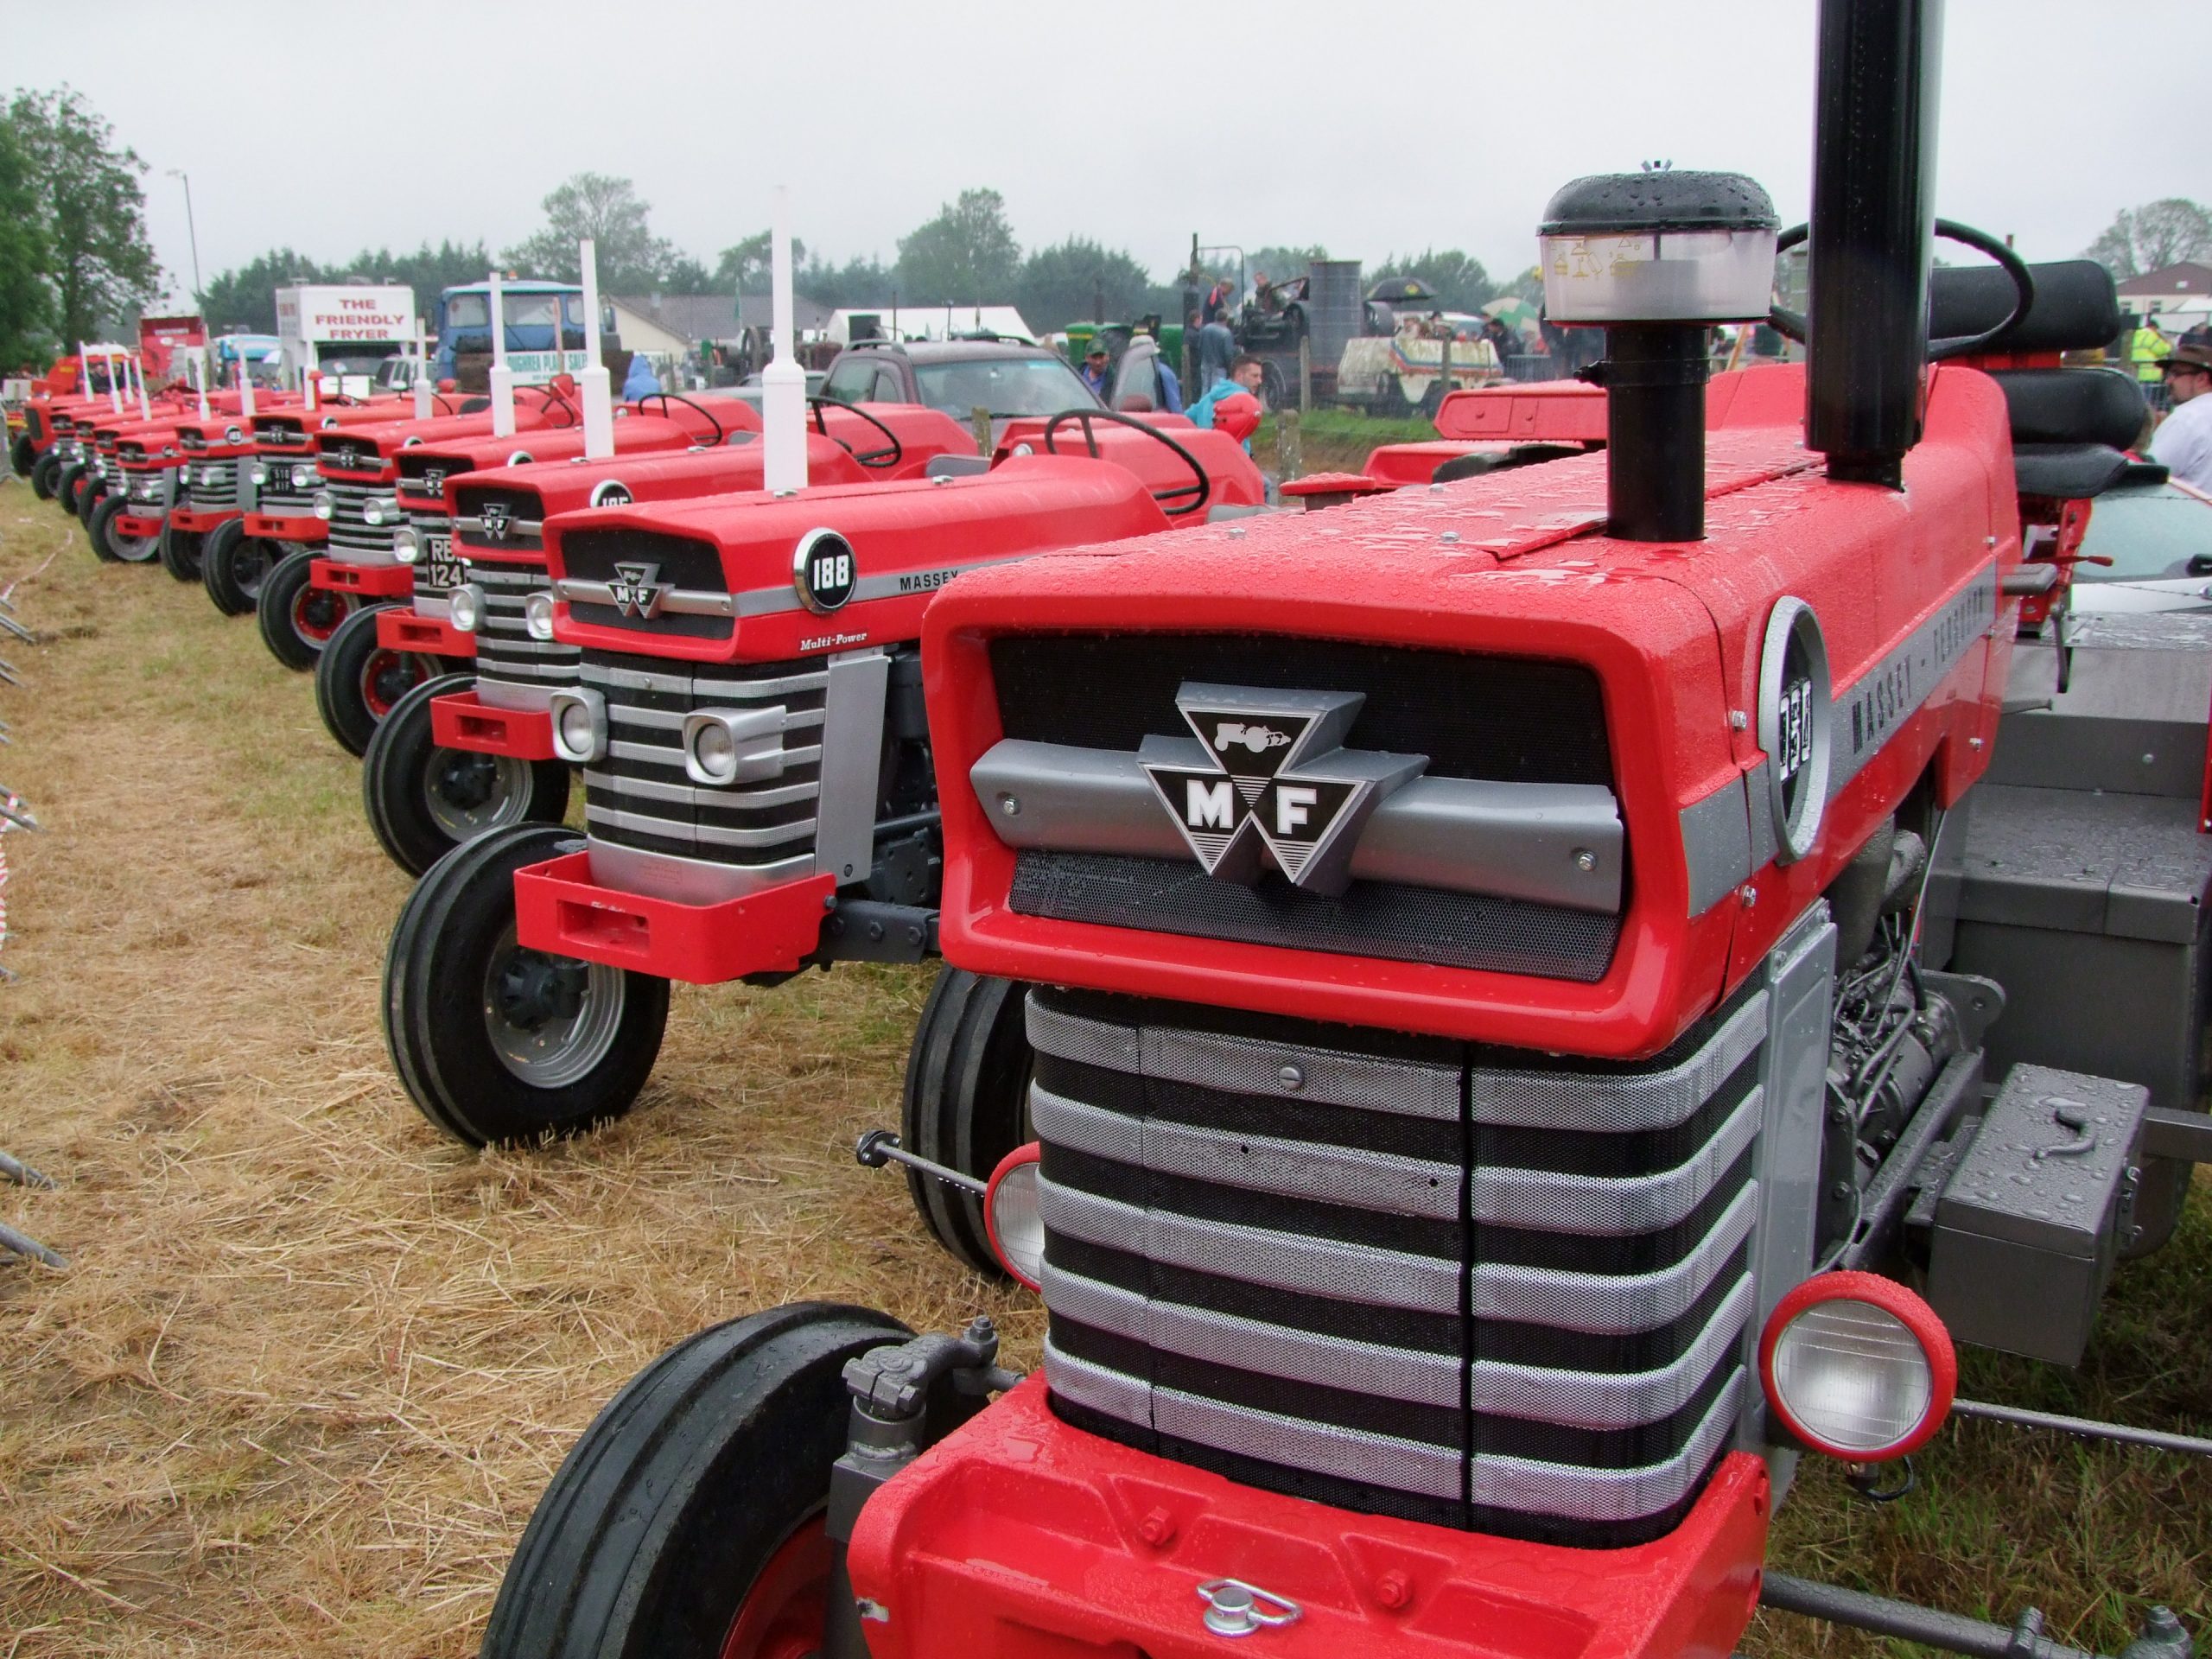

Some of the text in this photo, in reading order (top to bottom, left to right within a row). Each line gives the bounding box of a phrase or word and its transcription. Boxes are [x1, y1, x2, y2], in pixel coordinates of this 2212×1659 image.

[340, 299, 376, 309] THE
[315, 315, 404, 325] FRIENDLY
[329, 329, 389, 340] FRYER
[432, 539, 461, 562] RB
[430, 564, 462, 587] 124
[813, 554, 849, 591] 188
[800, 632, 868, 651] Multi-Power
[1852, 654, 1910, 754] MASSEY
